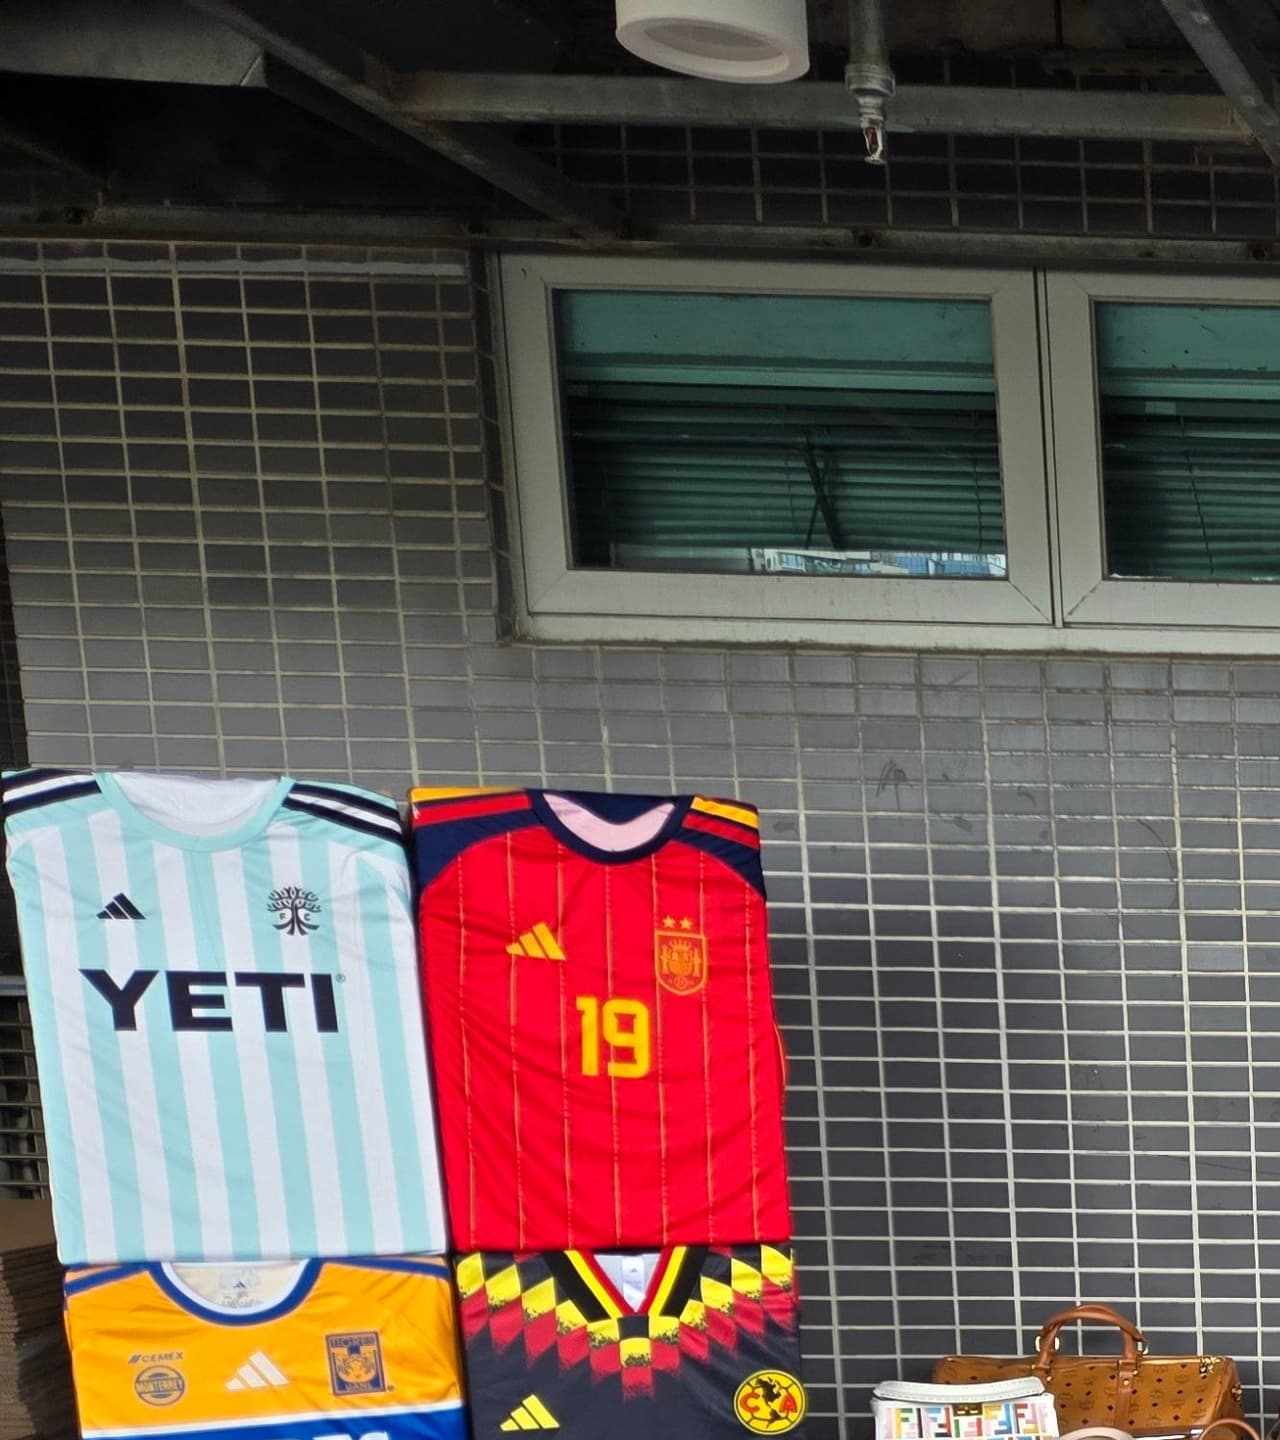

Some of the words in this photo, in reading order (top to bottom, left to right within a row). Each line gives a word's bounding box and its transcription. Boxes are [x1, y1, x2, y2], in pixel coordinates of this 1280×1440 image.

[79, 969, 339, 1033] YETI
[575, 995, 652, 1079] 19
[141, 1351, 184, 1363] CEMEX
